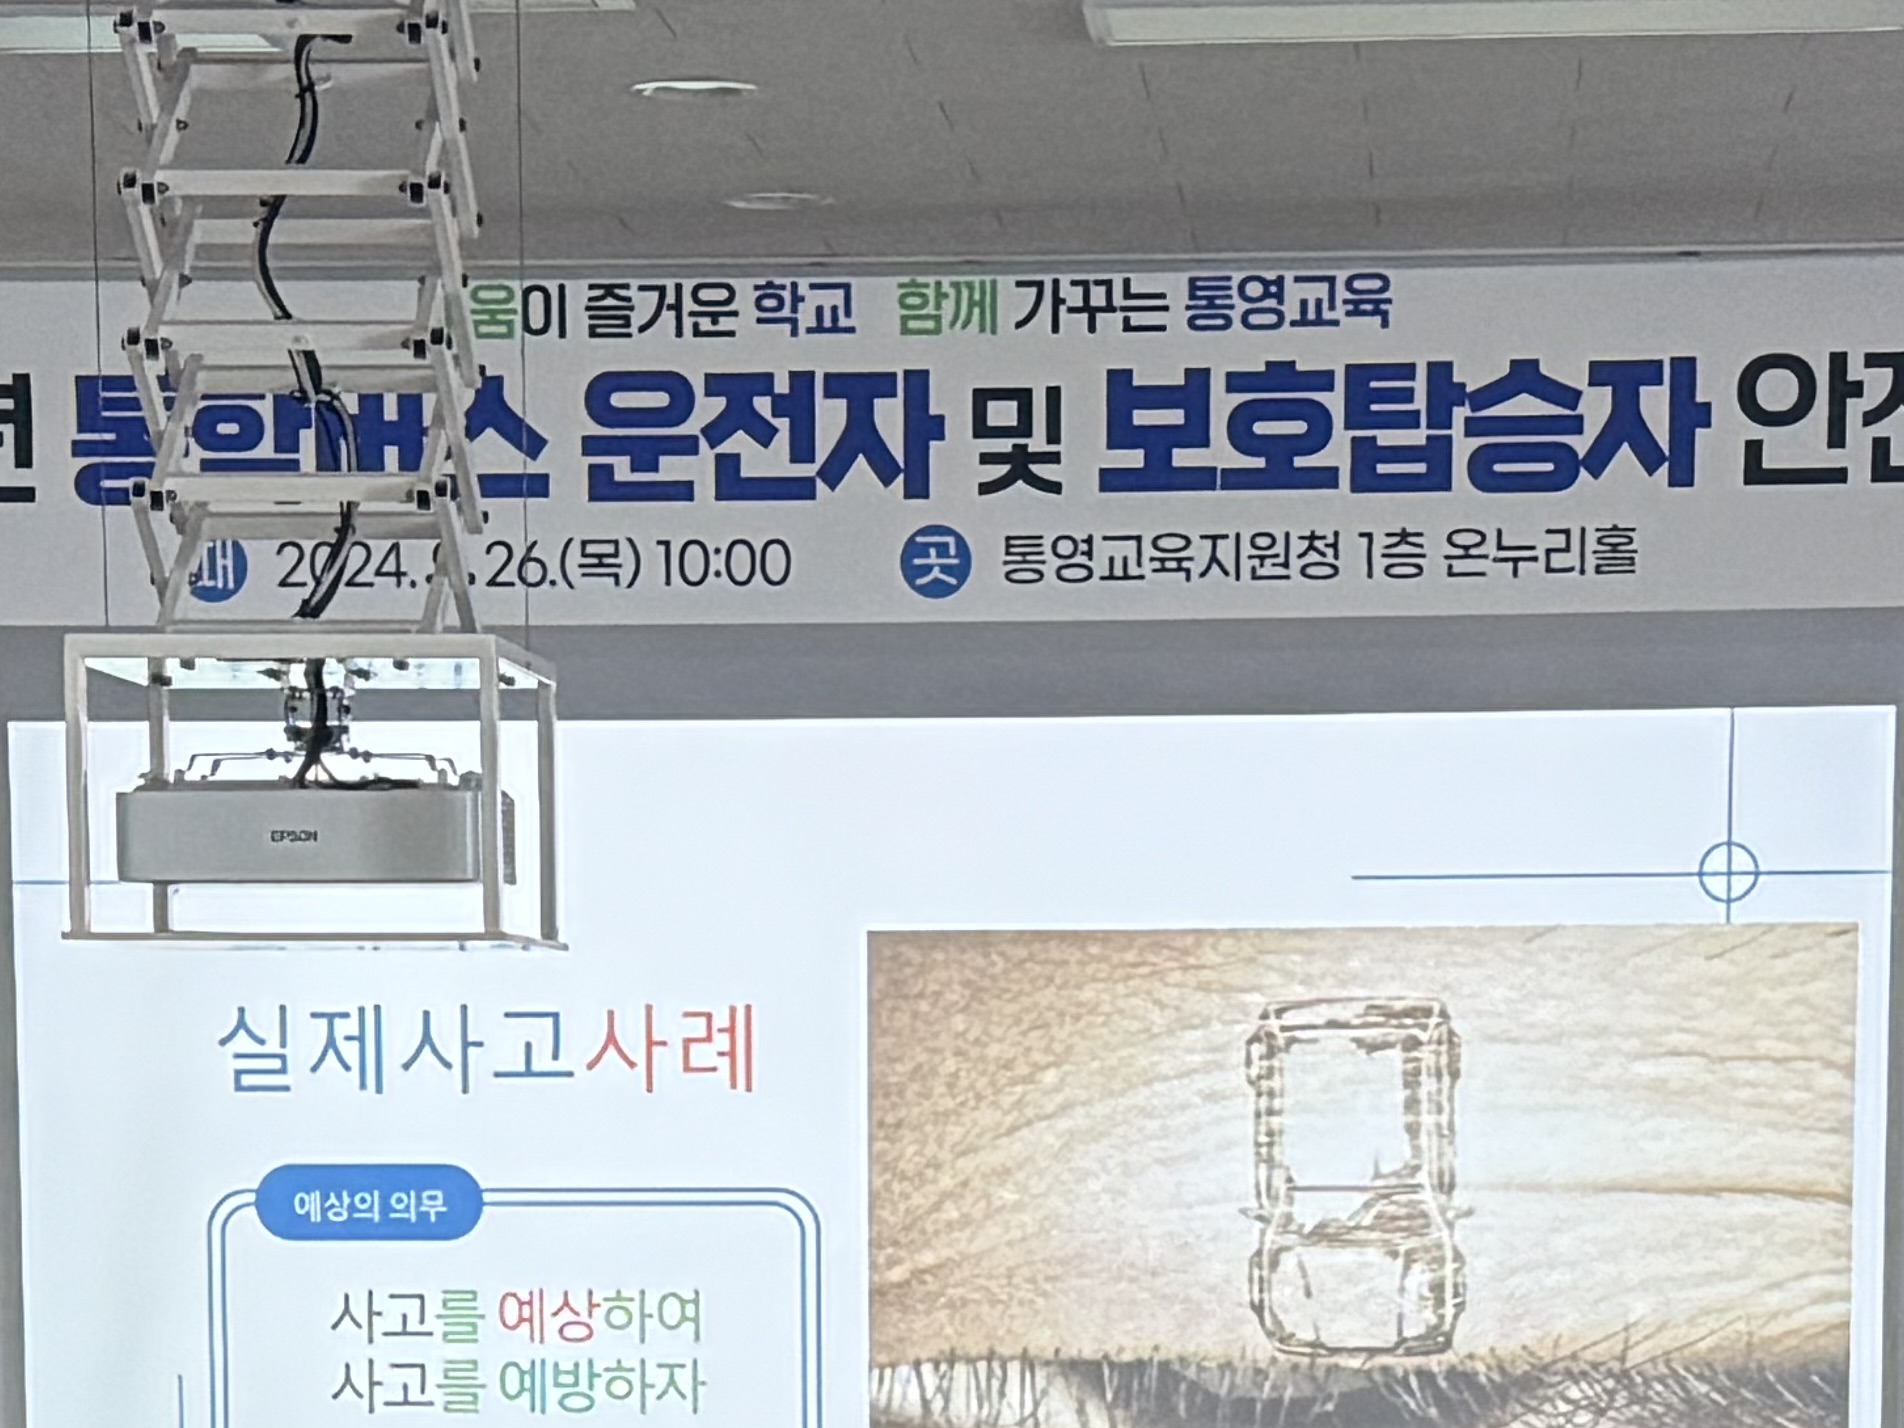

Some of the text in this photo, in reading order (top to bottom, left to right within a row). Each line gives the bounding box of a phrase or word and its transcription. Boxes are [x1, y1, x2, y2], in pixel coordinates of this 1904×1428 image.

[469, 271, 1393, 340] 움이 즐거운 학교 함께 가꾸는 통영교육
[581, 369, 946, 503] 운전자
[971, 385, 1063, 496] 및
[1098, 356, 1713, 494] 보호탑승자
[655, 536, 793, 589] 10:00
[911, 524, 1639, 588] 곳 통영교육지원청 1층 온누리홀
[270, 829, 319, 843] EPSON
[217, 1003, 754, 1095] 실제사고사례
[389, 1189, 449, 1223] 의무
[330, 1287, 701, 1345] 사고를 예상하여
[331, 1357, 708, 1415] 사고를 예방하자
